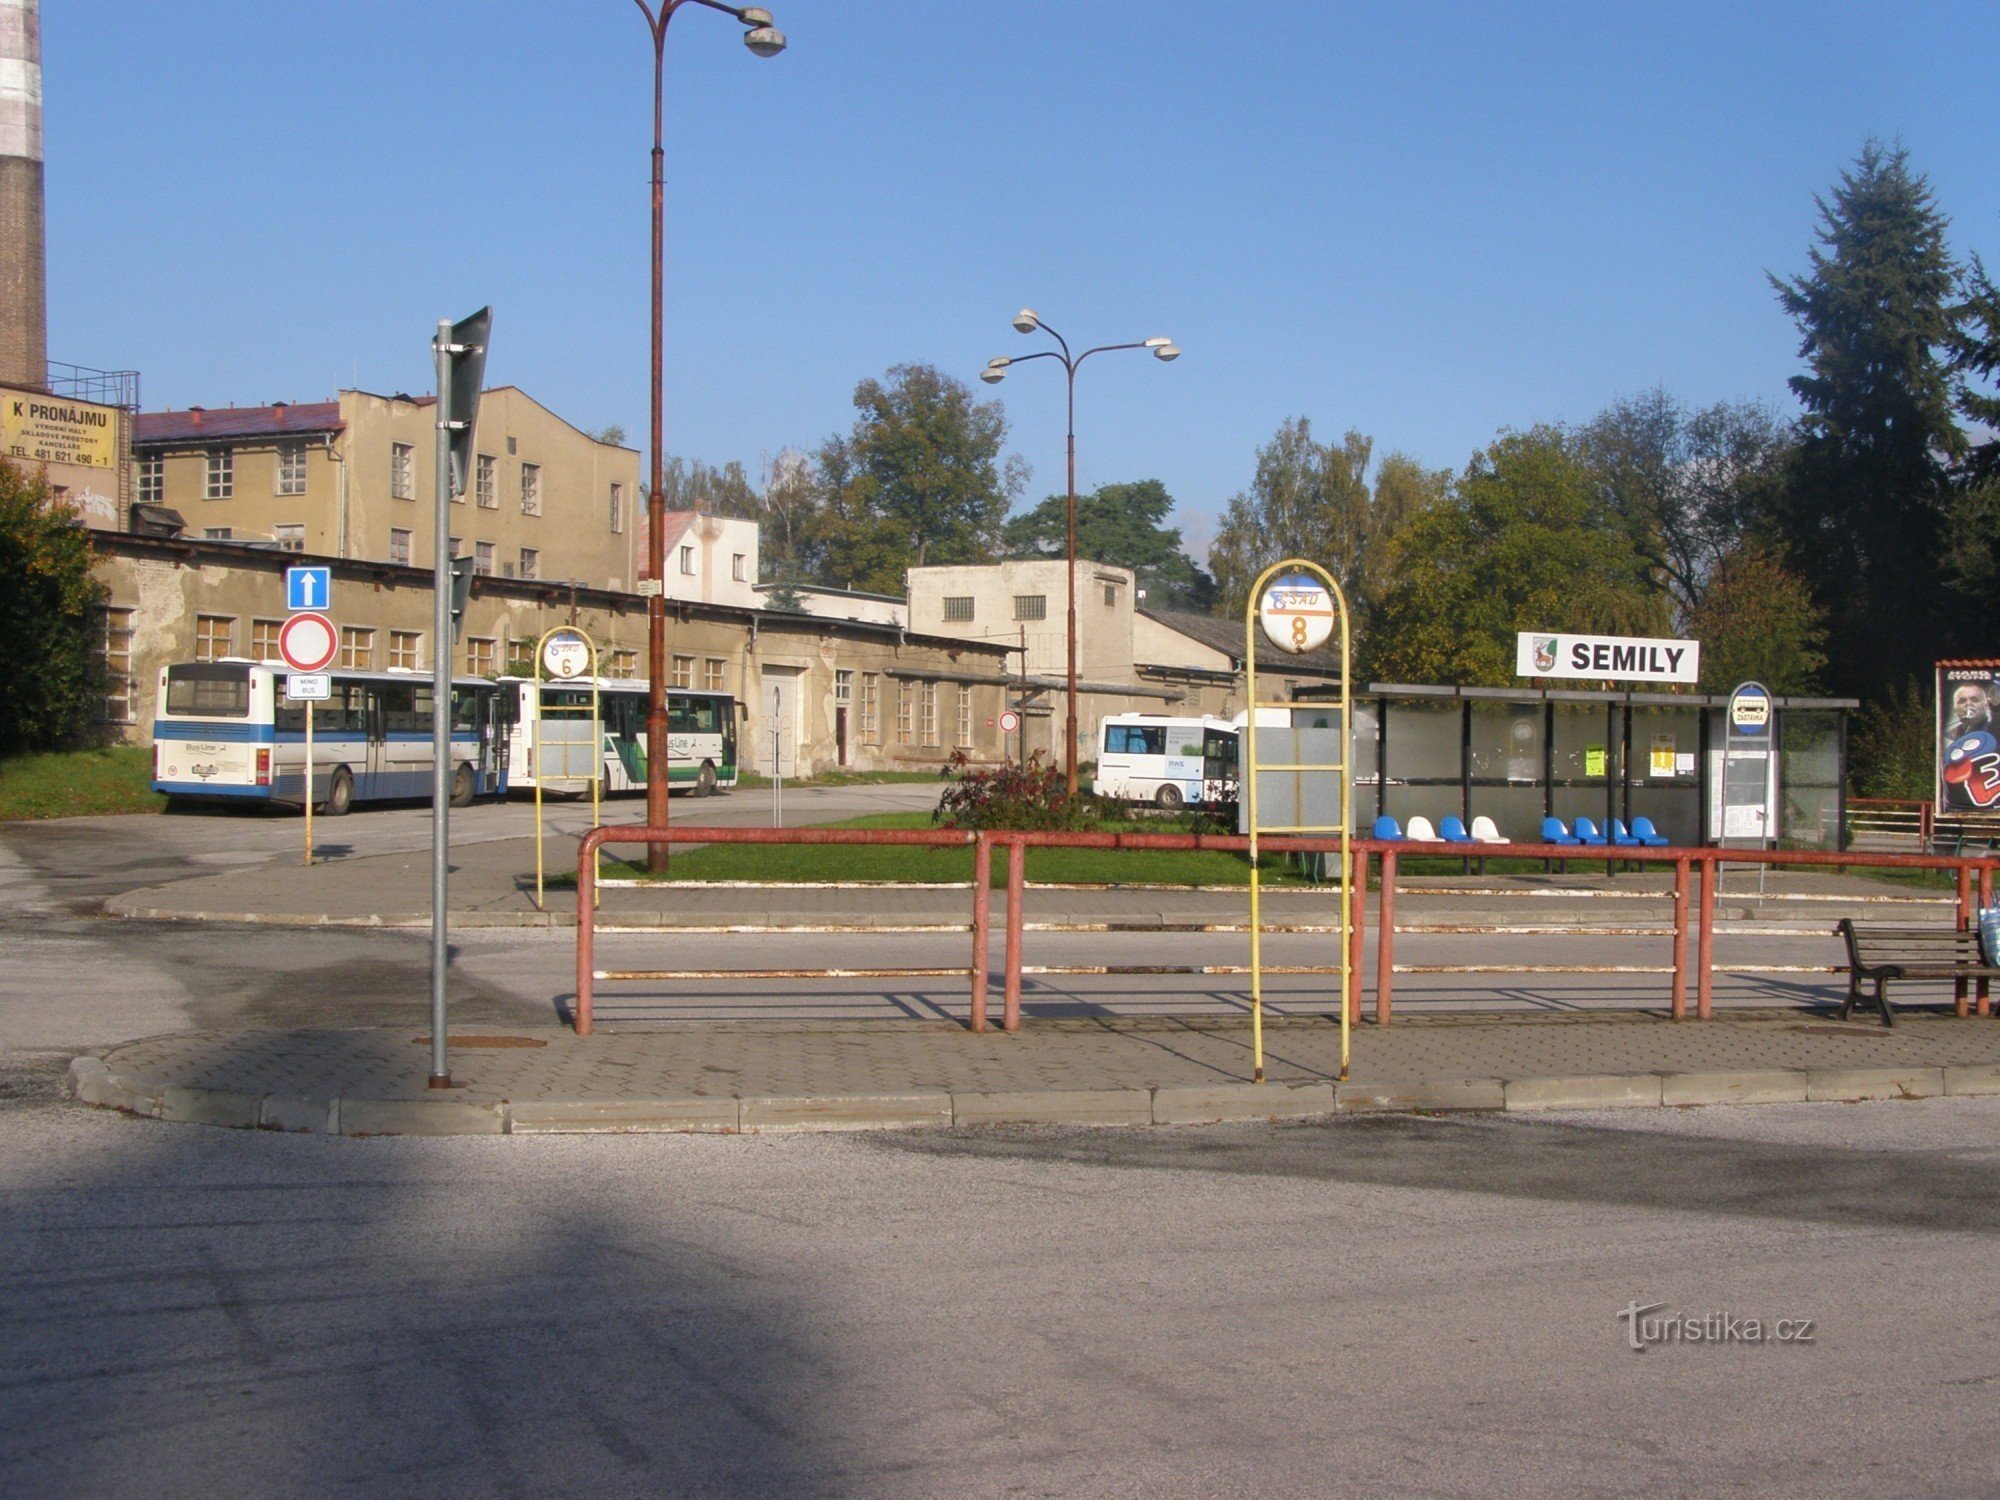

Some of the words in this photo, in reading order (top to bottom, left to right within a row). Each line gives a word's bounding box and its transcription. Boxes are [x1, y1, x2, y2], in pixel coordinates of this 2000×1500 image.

[13, 401, 23, 417] K
[30, 404, 107, 428] PRONÁJMU
[61, 434, 99, 444] PROSTORY
[10, 445, 30, 458] TEL.
[34, 448, 51, 460] 481
[55, 451, 71, 462] 621
[75, 453, 92, 465] 490
[103, 457, 108, 466] 1
[1291, 616, 1307, 645] 8
[562, 658, 571, 675] 6
[1571, 642, 1685, 674] SEMILY
